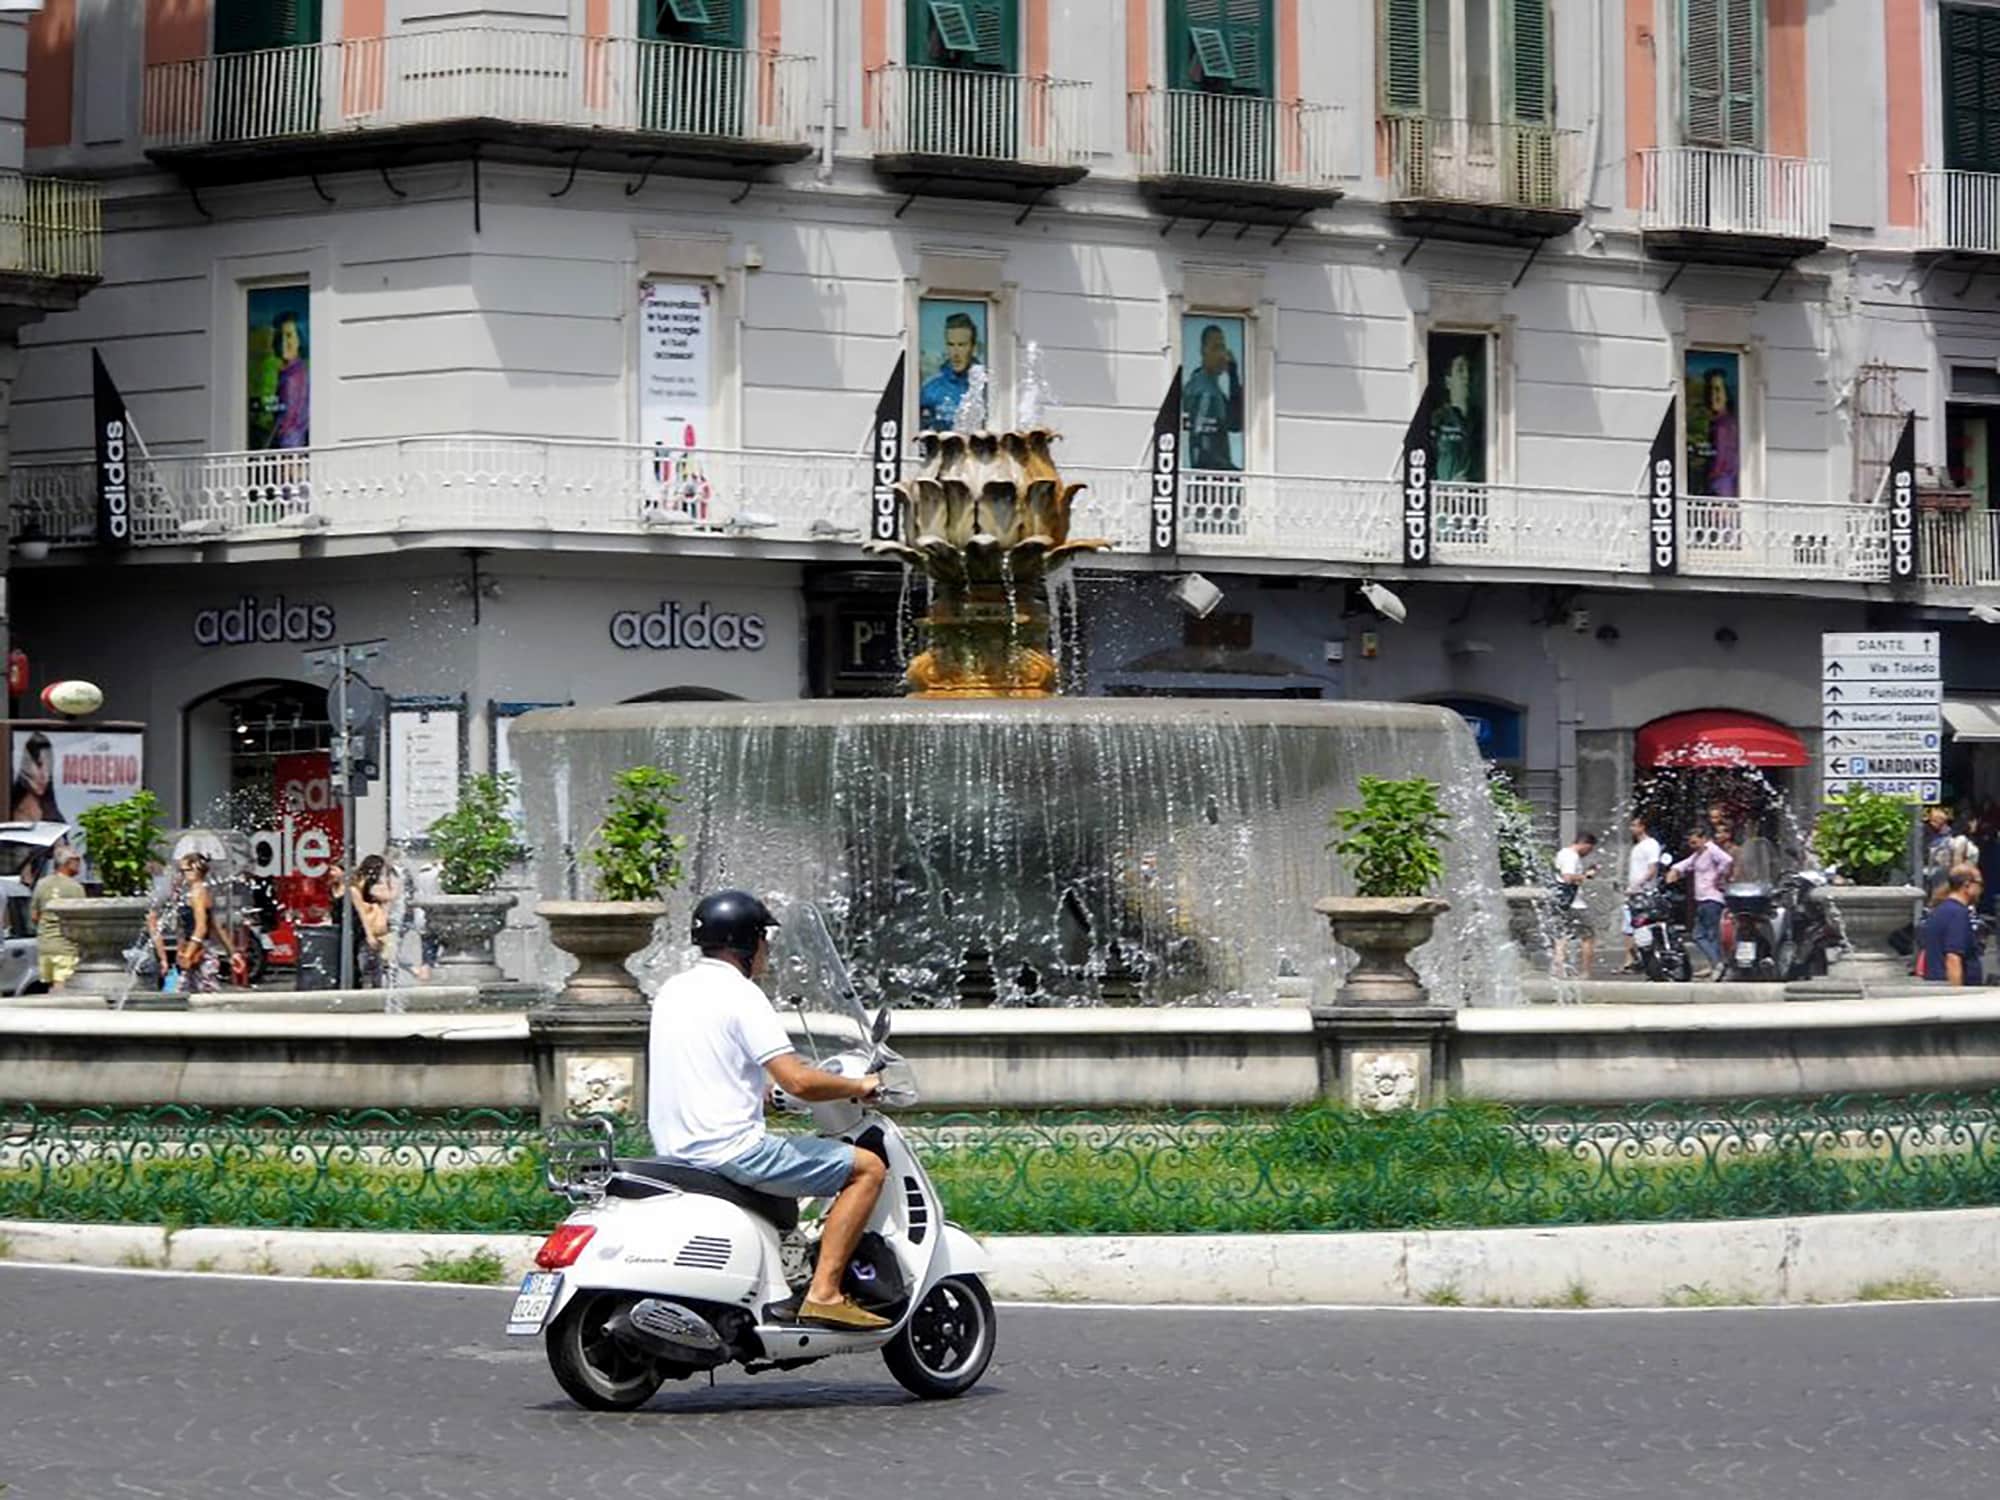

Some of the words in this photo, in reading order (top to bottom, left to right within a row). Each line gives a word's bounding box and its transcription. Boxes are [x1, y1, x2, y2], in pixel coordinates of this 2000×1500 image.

[103, 420, 128, 538] adidas
[874, 420, 898, 539] adidas
[1153, 432, 1175, 548] adidas
[1405, 448, 1426, 560] adidas
[1652, 459, 1672, 567] adidas
[1891, 470, 1912, 575] adidas
[194, 595, 336, 645] adidas
[610, 600, 766, 650] adidas
[1857, 640, 1905, 651] DANTE
[1870, 662, 1889, 673] Via
[1894, 661, 1936, 673] Toledo
[1869, 686, 1935, 698] Funicolare
[63, 754, 138, 785] MORENO
[1868, 758, 1938, 774] NARDONES
